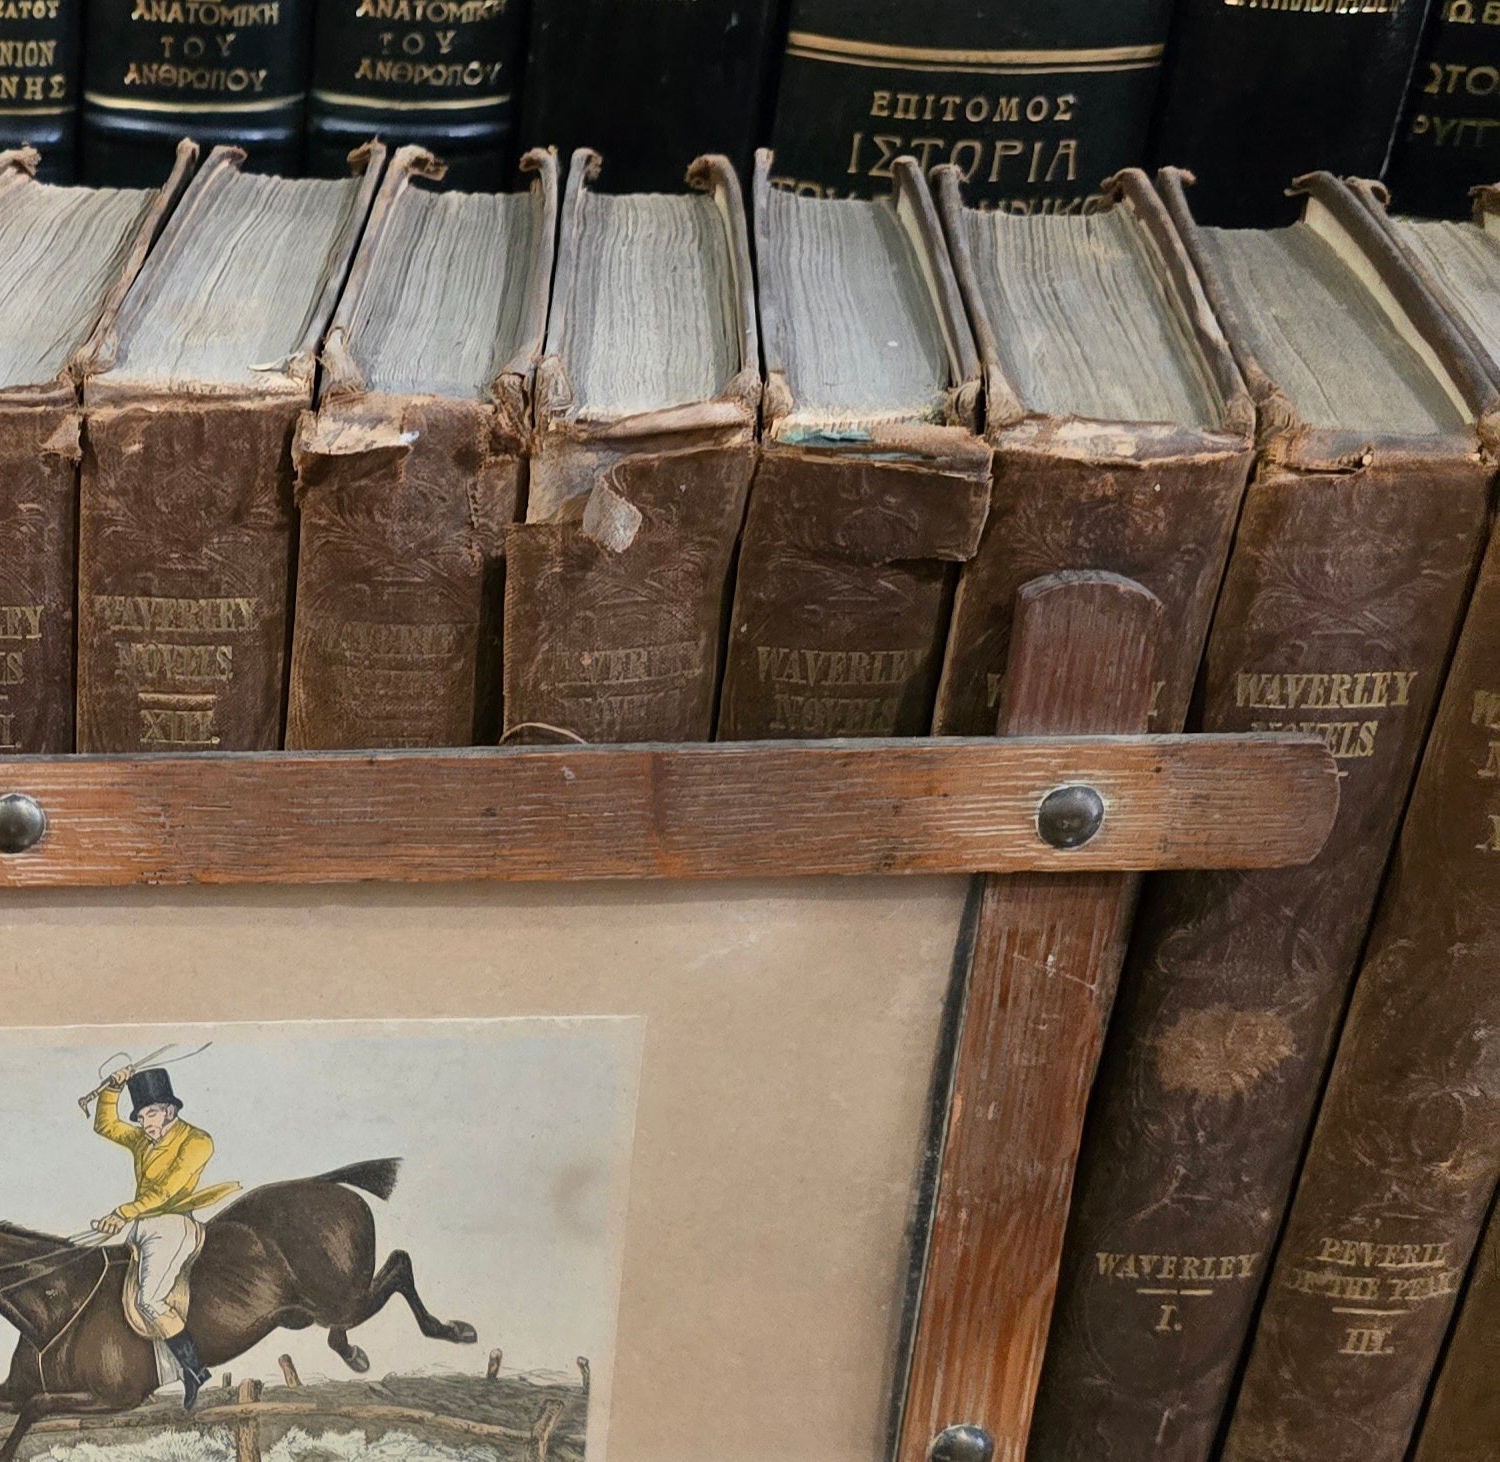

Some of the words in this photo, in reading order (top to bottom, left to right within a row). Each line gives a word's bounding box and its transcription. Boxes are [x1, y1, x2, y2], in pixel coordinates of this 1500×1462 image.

[131, 0, 281, 28] ΑΝΑΤΟΜΙΚΗ
[160, 32, 237, 59] ΤΟΥ
[379, 29, 458, 55] ΤΟΥ
[870, 90, 1078, 123] ΕΠΙΤΟΜΟΣ
[1234, 671, 1419, 710] WAVERLEY
[1095, 1250, 1262, 1281] WAVERLEY
